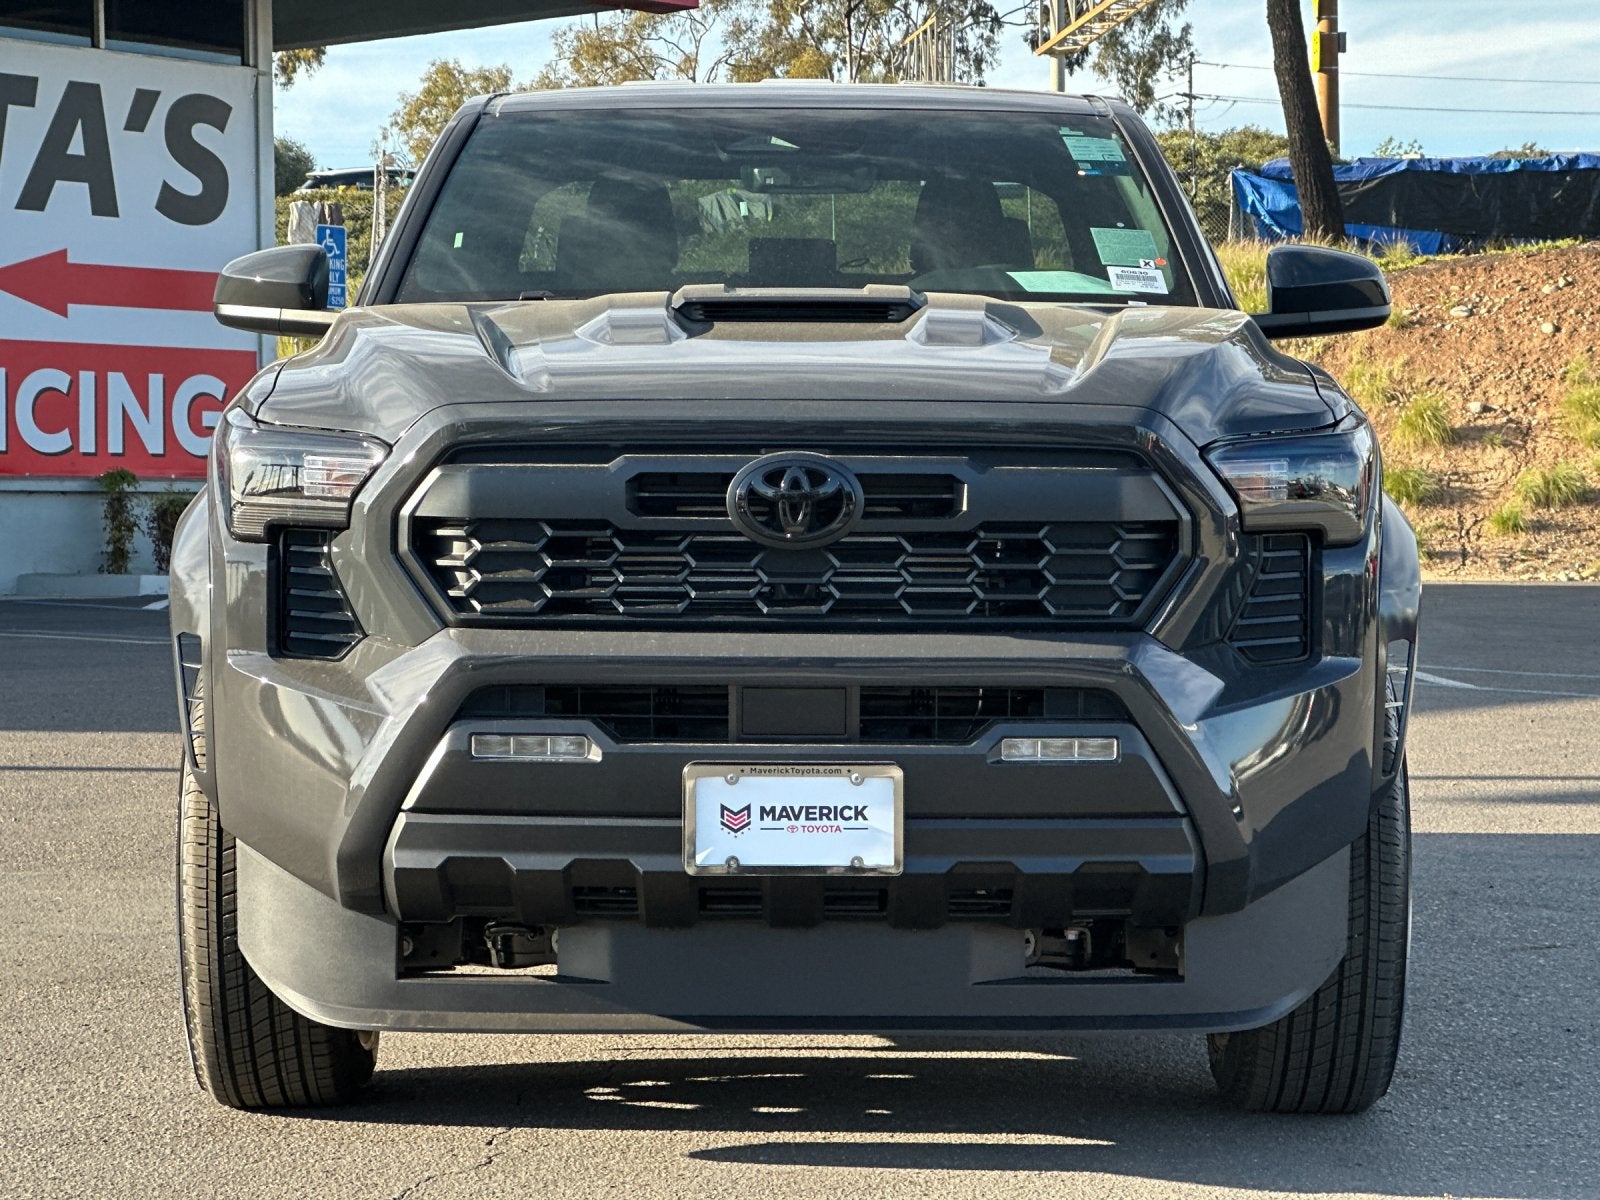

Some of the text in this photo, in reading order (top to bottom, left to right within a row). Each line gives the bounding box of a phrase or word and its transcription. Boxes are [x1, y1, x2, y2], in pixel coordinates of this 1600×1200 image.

[329, 258, 345, 271] KING
[750, 767, 842, 776] MaverickToyota.com
[759, 805, 869, 821] MAVERICK
[801, 825, 842, 833] TOYOTA
